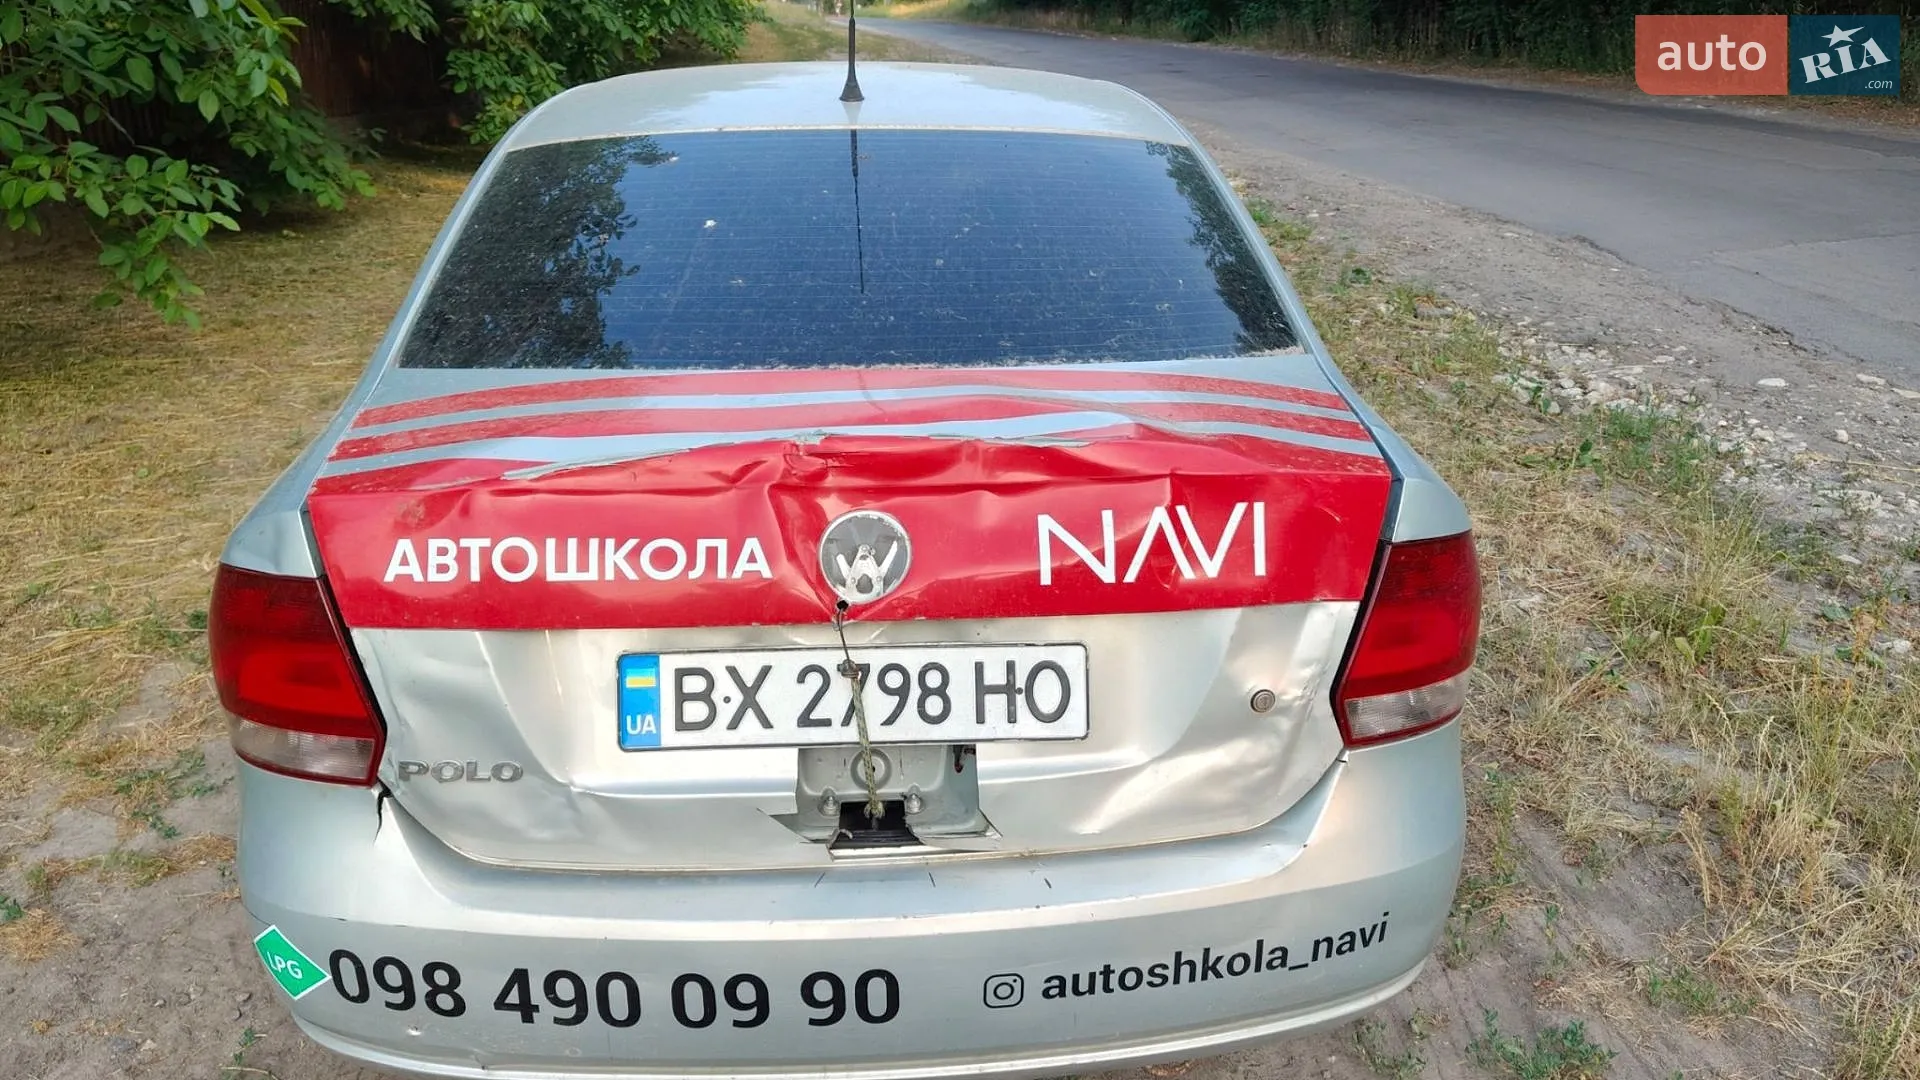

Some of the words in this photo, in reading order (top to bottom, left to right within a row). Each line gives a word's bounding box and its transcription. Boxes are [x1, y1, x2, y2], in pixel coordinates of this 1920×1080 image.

[383, 537, 773, 583] АВТОШКОЛА
[1037, 502, 1267, 585] NAVI
[797, 662, 952, 728] 2798
[626, 714, 657, 735] UA
[398, 759, 524, 783] POLO
[266, 951, 303, 980] LPG
[1042, 912, 1390, 999] autoshkola_navi
[329, 949, 467, 1018] 098
[493, 967, 642, 1028] 490
[671, 973, 770, 1028] 09
[800, 969, 900, 1027] 90
